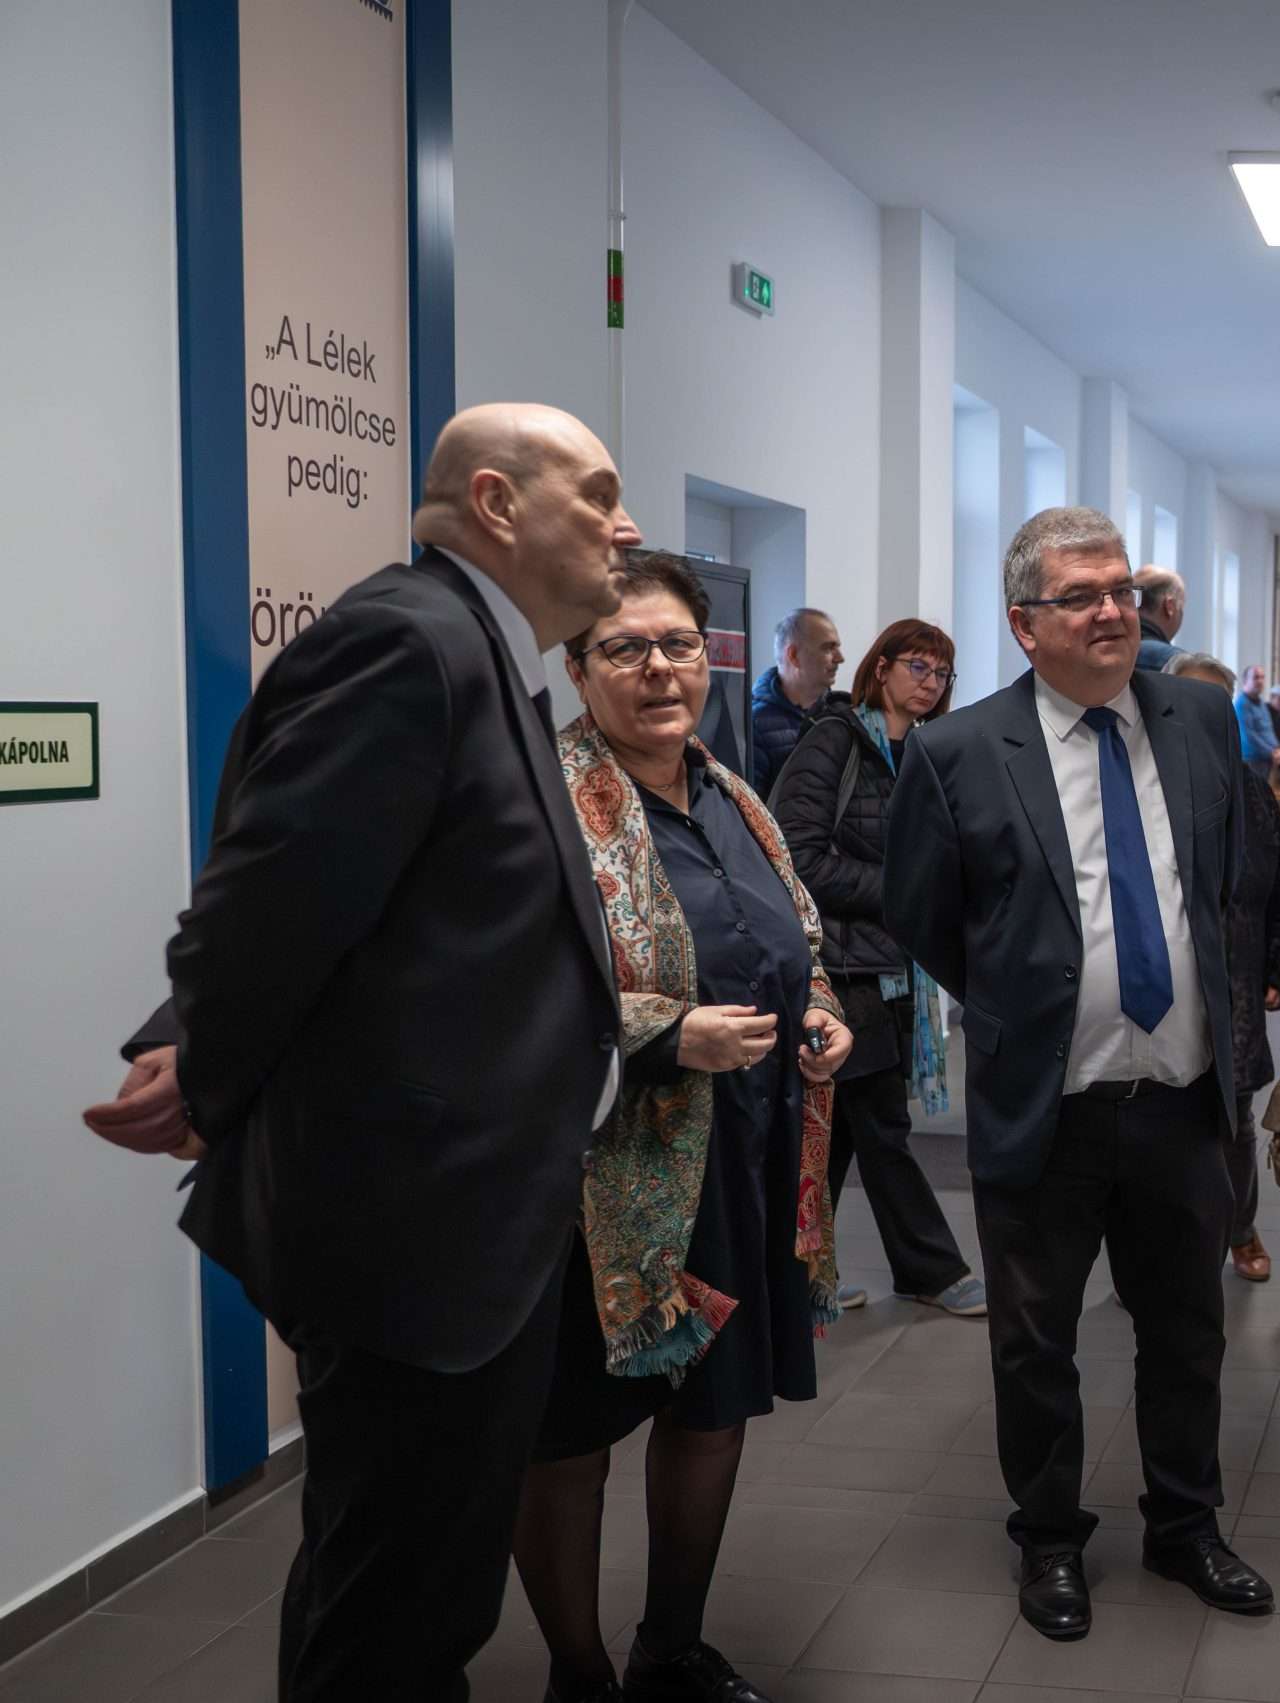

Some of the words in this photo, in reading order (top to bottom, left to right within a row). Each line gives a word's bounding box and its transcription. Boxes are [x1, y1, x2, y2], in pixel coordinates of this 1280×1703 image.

[265, 315, 298, 361] „A
[306, 322, 376, 384] Lélek
[251, 382, 396, 447] gyümölcse
[288, 454, 368, 509] pedig:
[251, 587, 328, 648] örö
[0, 736, 70, 765] KÁPOLNA
